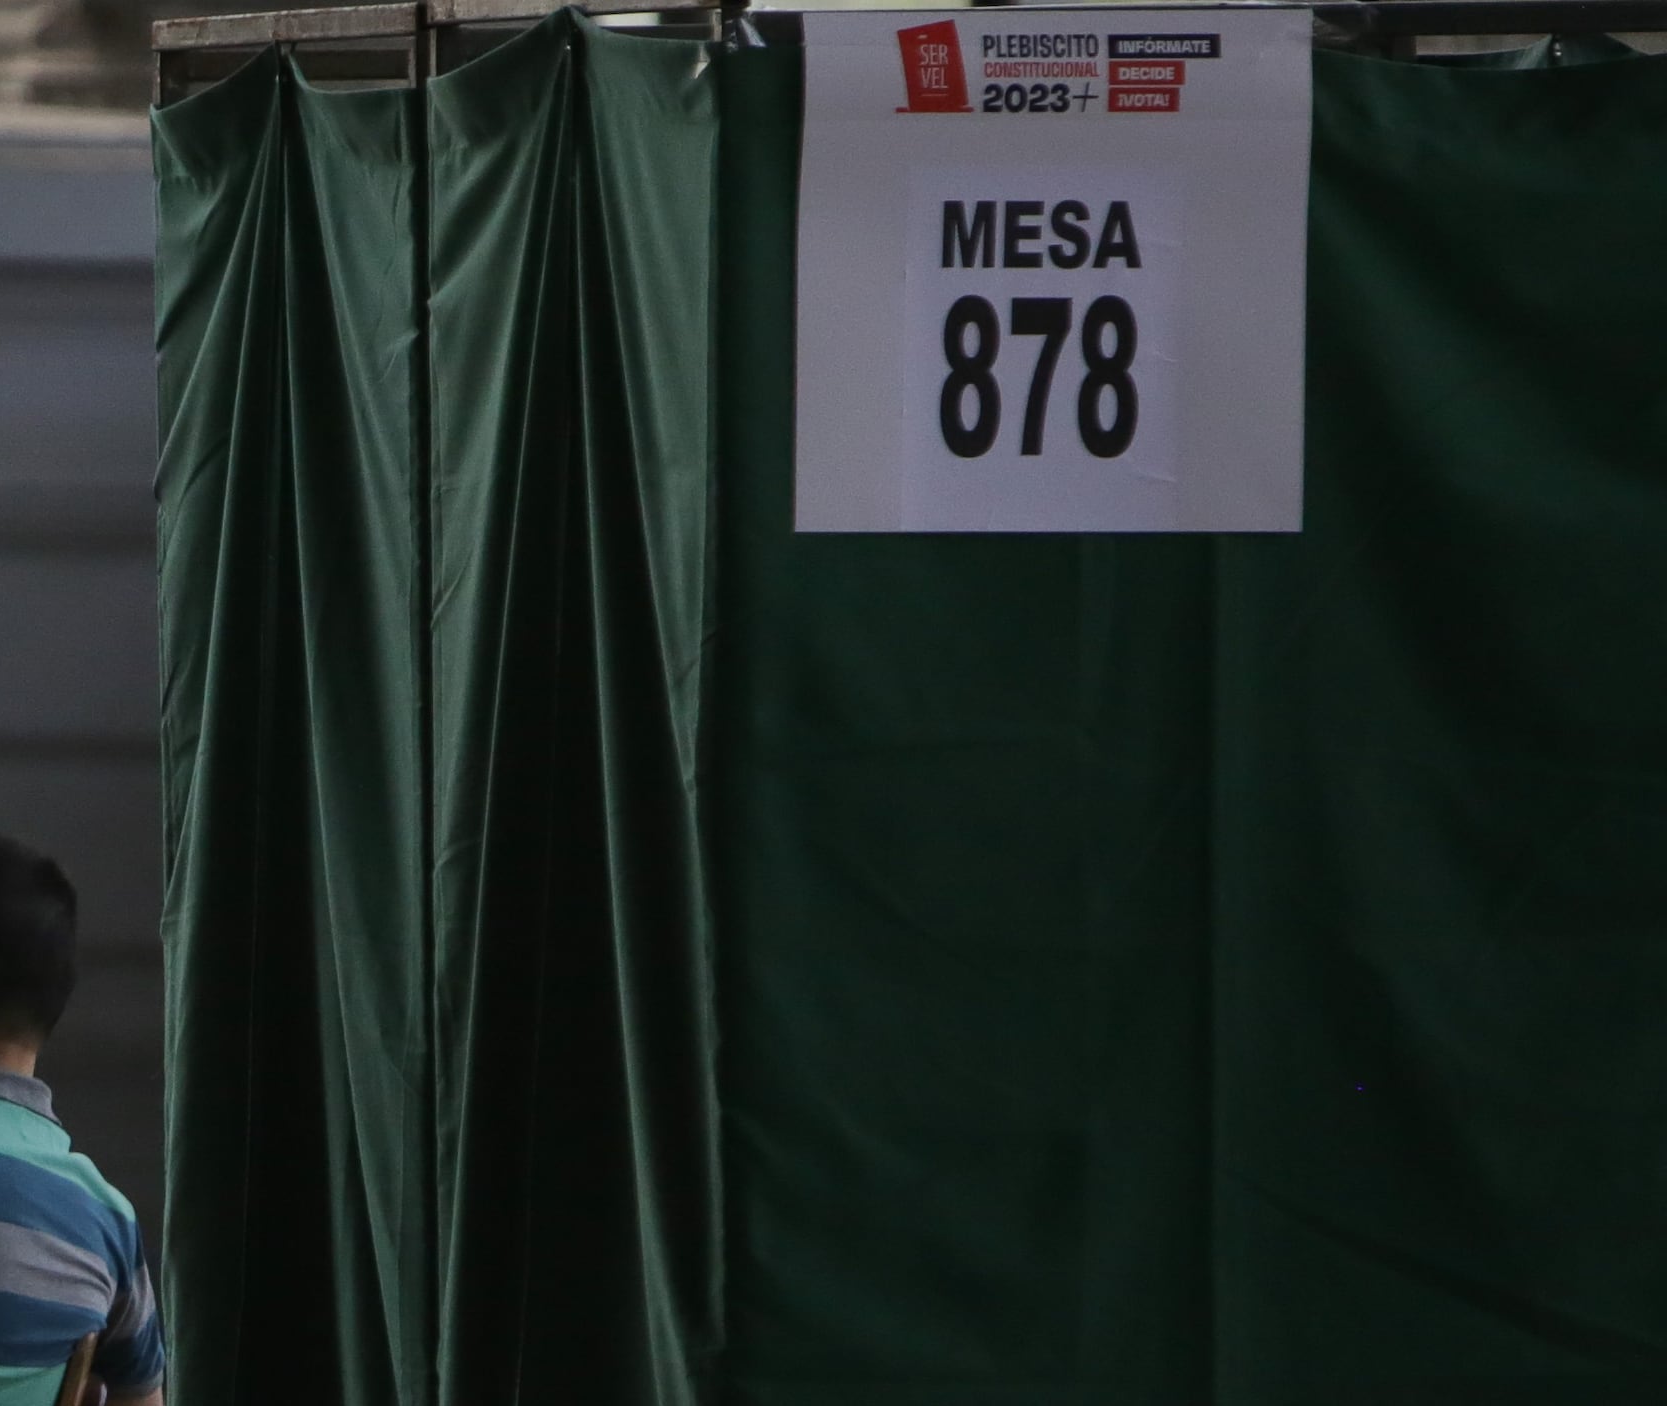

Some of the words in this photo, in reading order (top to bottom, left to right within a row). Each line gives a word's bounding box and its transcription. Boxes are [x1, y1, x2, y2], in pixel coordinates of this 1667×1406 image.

[920, 43, 949, 66] SER
[982, 33, 1100, 58] PLEBISCITO
[1118, 36, 1212, 54] INFÓRMATE
[920, 69, 949, 89] VEL
[983, 61, 1100, 78] CONSTITUCIONAL
[1118, 66, 1175, 80] DECIDE
[940, 200, 1142, 270] MESA
[939, 294, 1139, 459] 878
